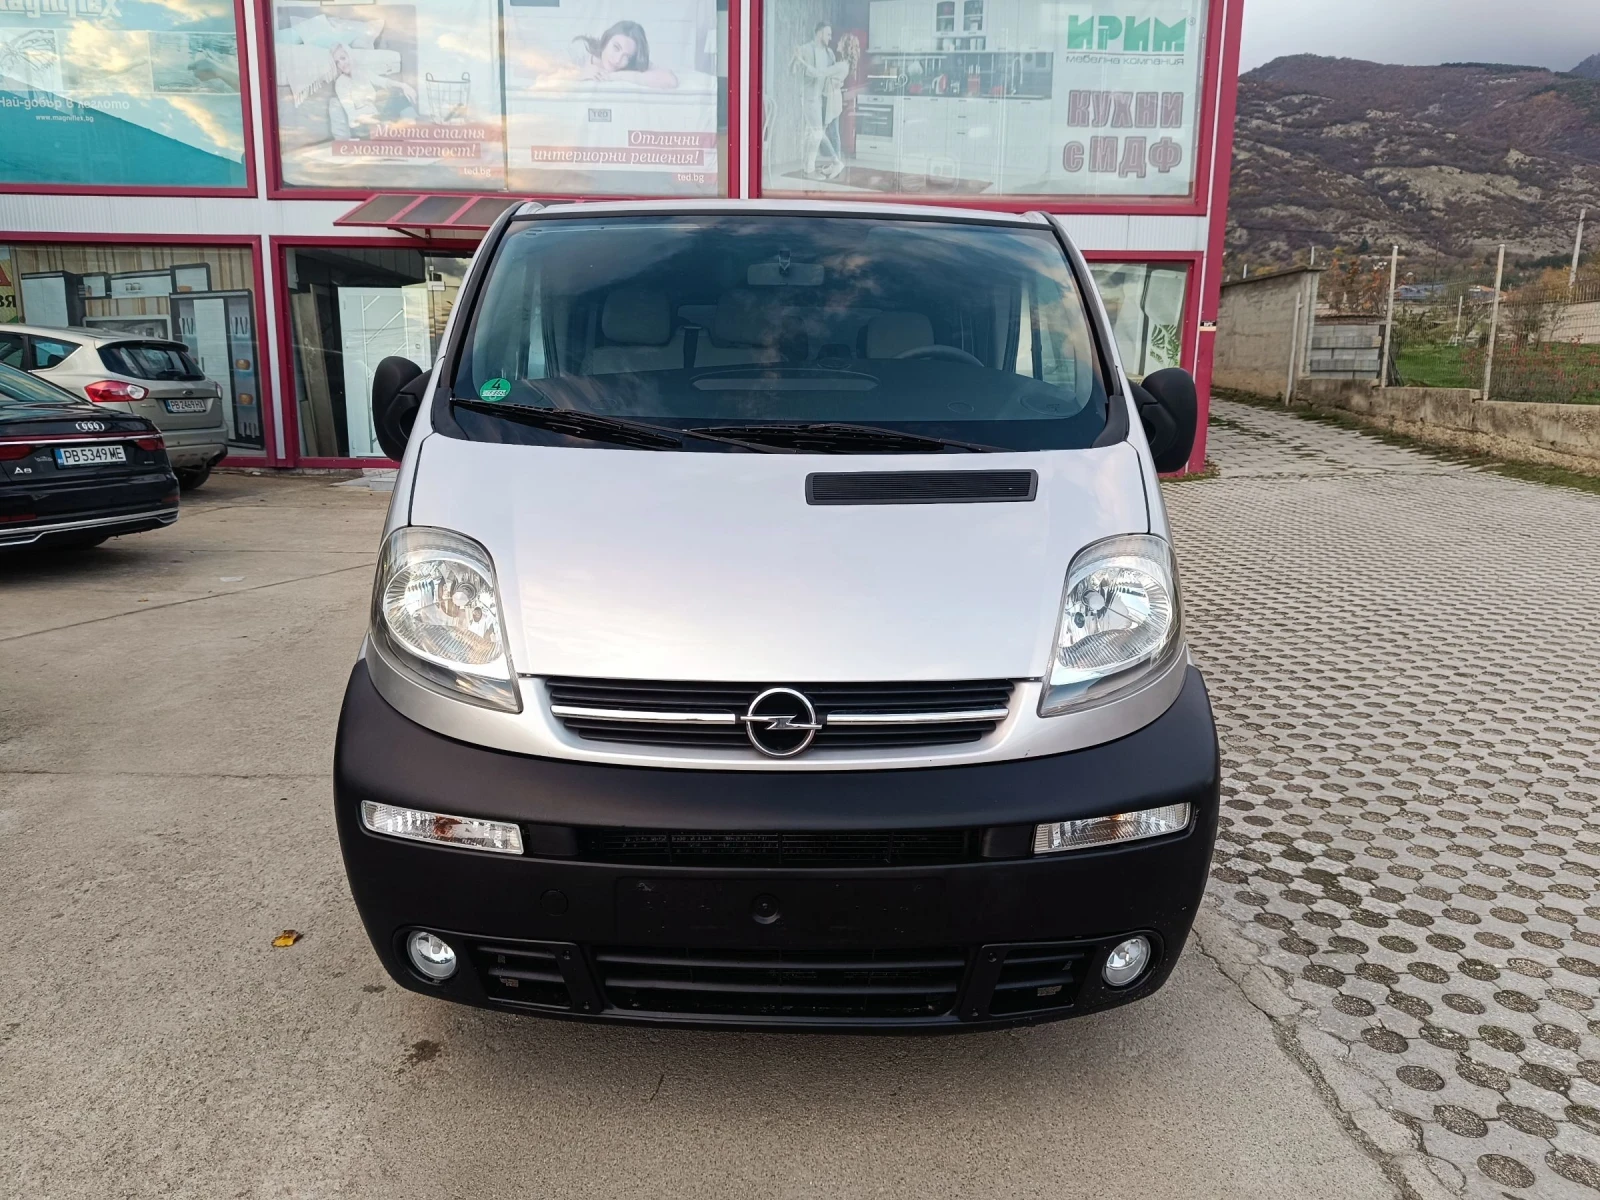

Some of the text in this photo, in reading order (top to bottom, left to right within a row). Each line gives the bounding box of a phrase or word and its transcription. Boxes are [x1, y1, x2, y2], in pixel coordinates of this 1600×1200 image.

[1066, 14, 1187, 52] ИРИМ
[1123, 57, 1185, 66] компания
[1067, 89, 1184, 129] КУХНИ
[35, 115, 94, 123] www.magniflex.bg
[374, 124, 485, 139] Моята спалня
[630, 130, 700, 146] Отлични
[340, 143, 476, 158] е моята крепост!
[533, 149, 699, 165] интериорни решения!
[463, 166, 492, 177] ted.bg
[677, 173, 705, 183] ted.bg
[491, 378, 502, 390] 4
